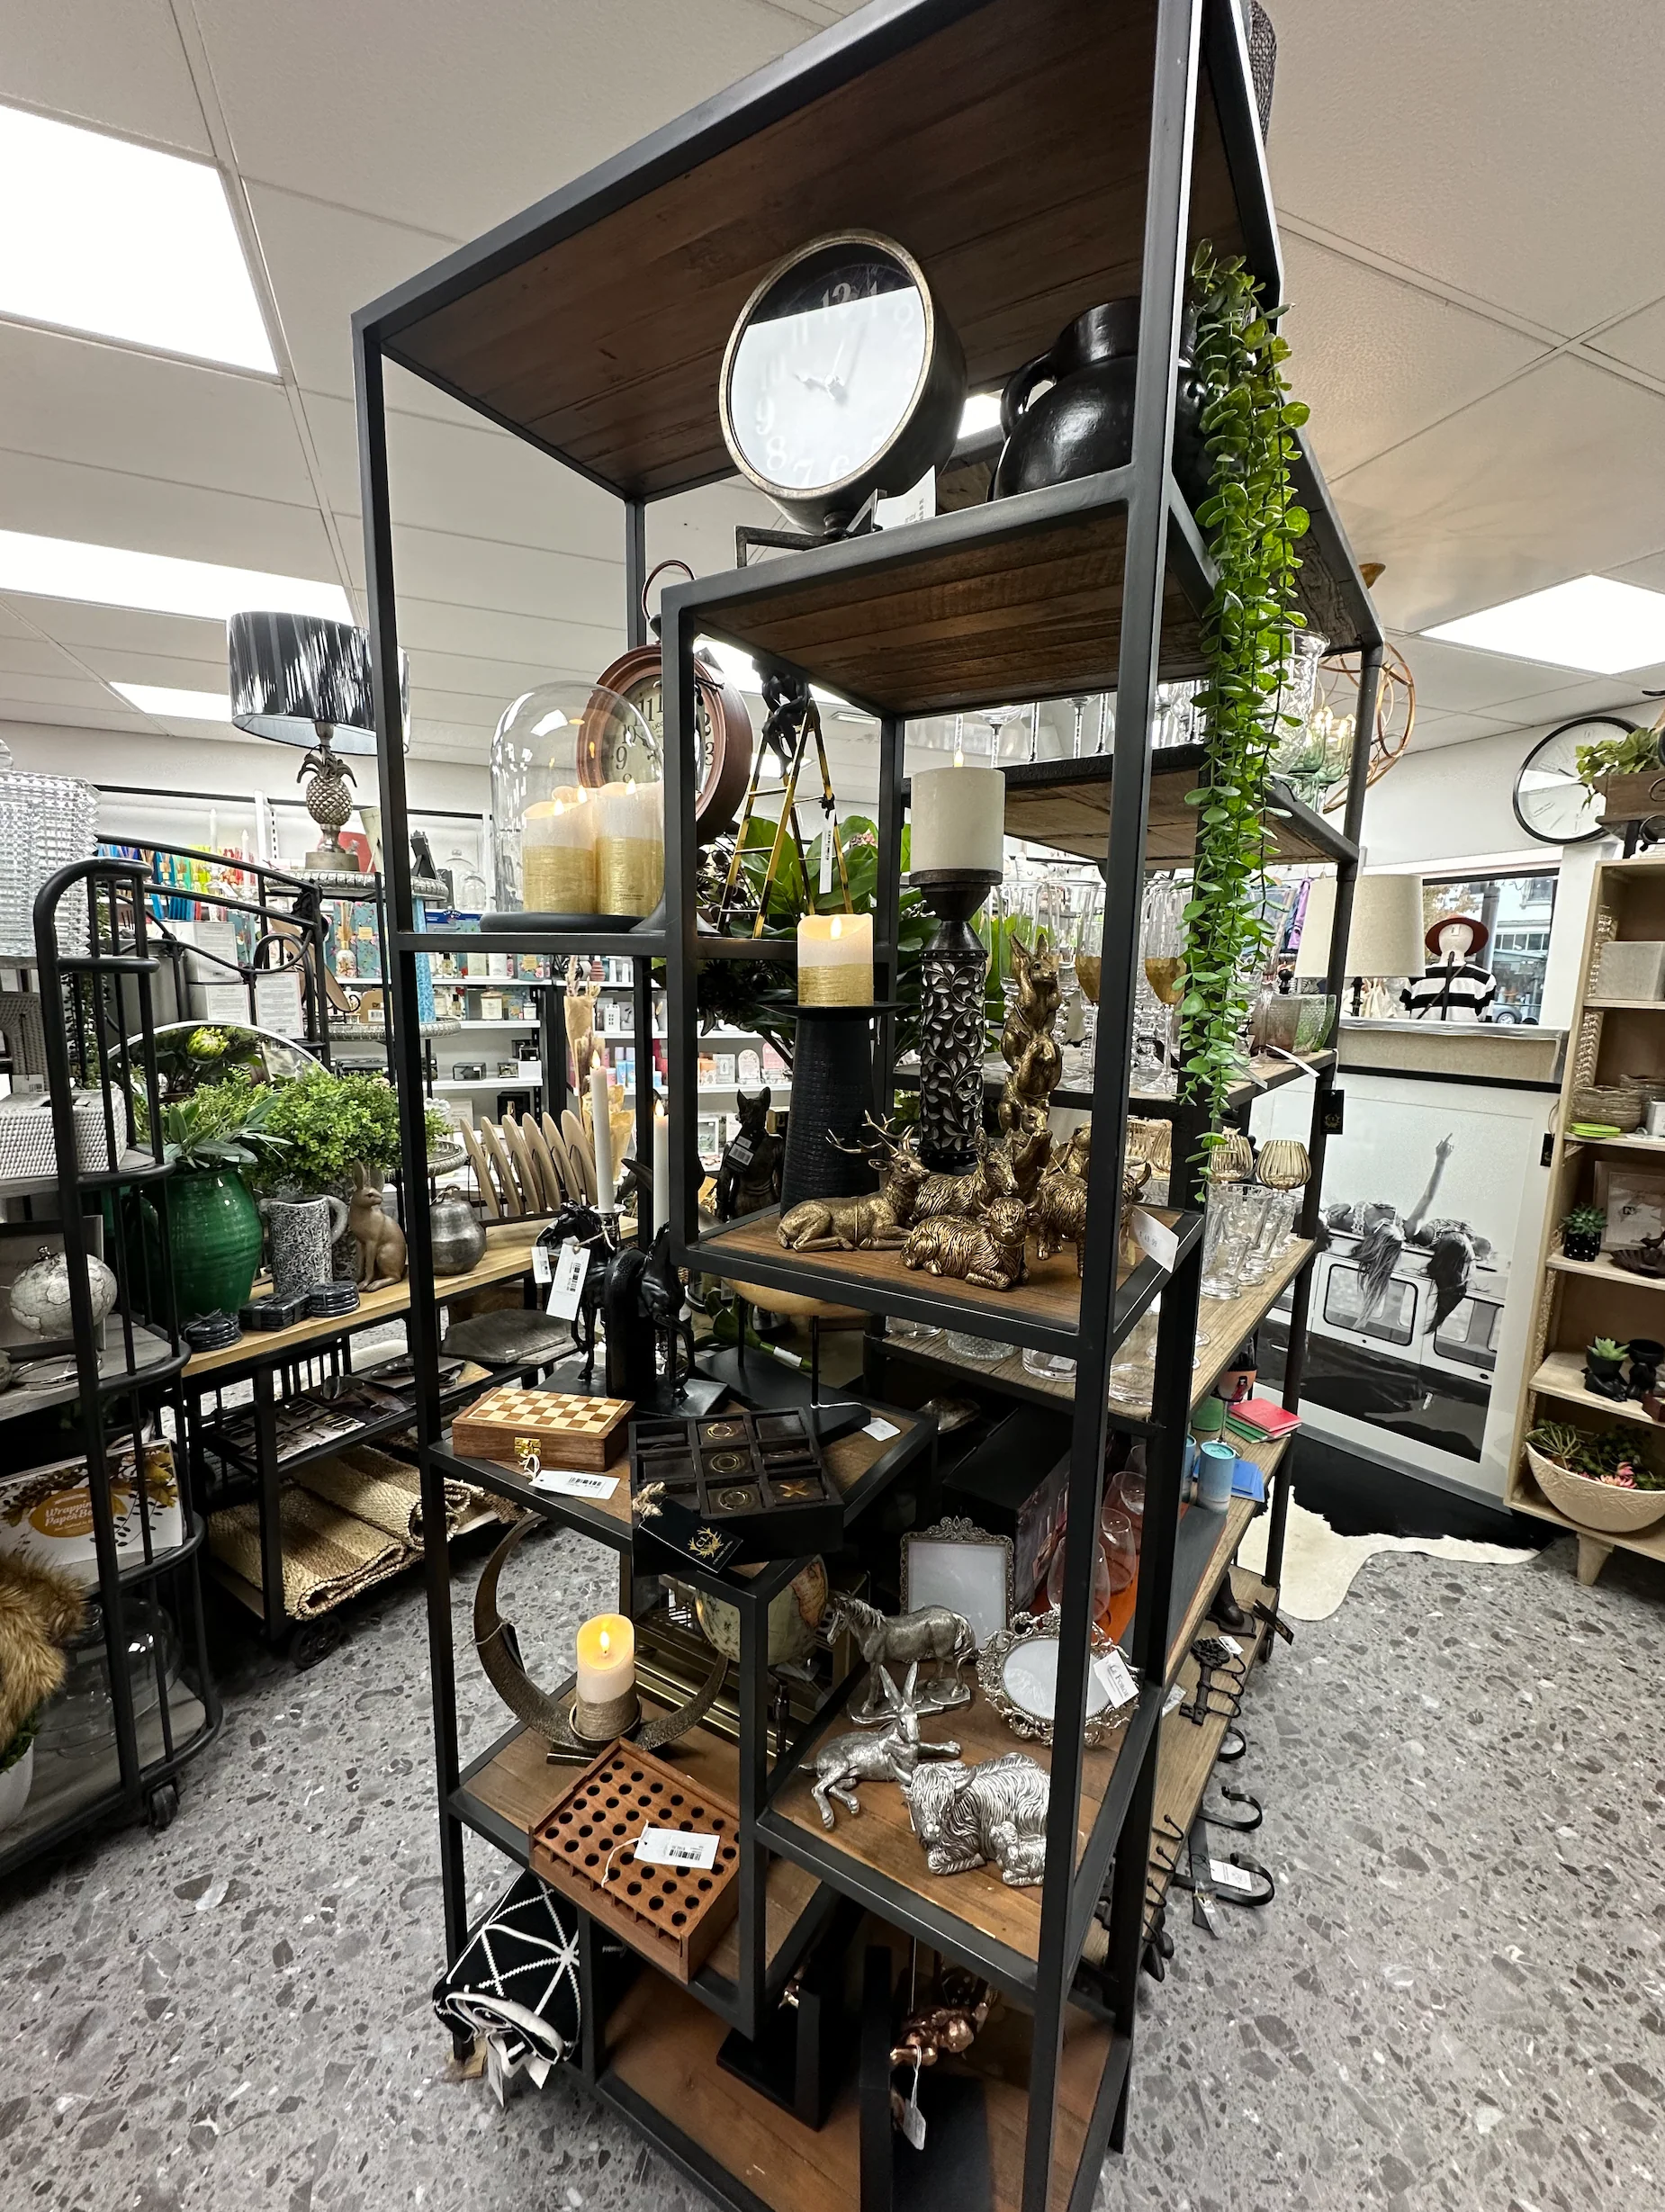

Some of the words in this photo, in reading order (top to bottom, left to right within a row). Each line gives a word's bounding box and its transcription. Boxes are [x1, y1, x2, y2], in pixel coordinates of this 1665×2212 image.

[755, 397, 776, 435] 9
[766, 436, 788, 471] 8
[616, 746, 627, 769] 9
[46, 1500, 93, 1518] Wrappin
